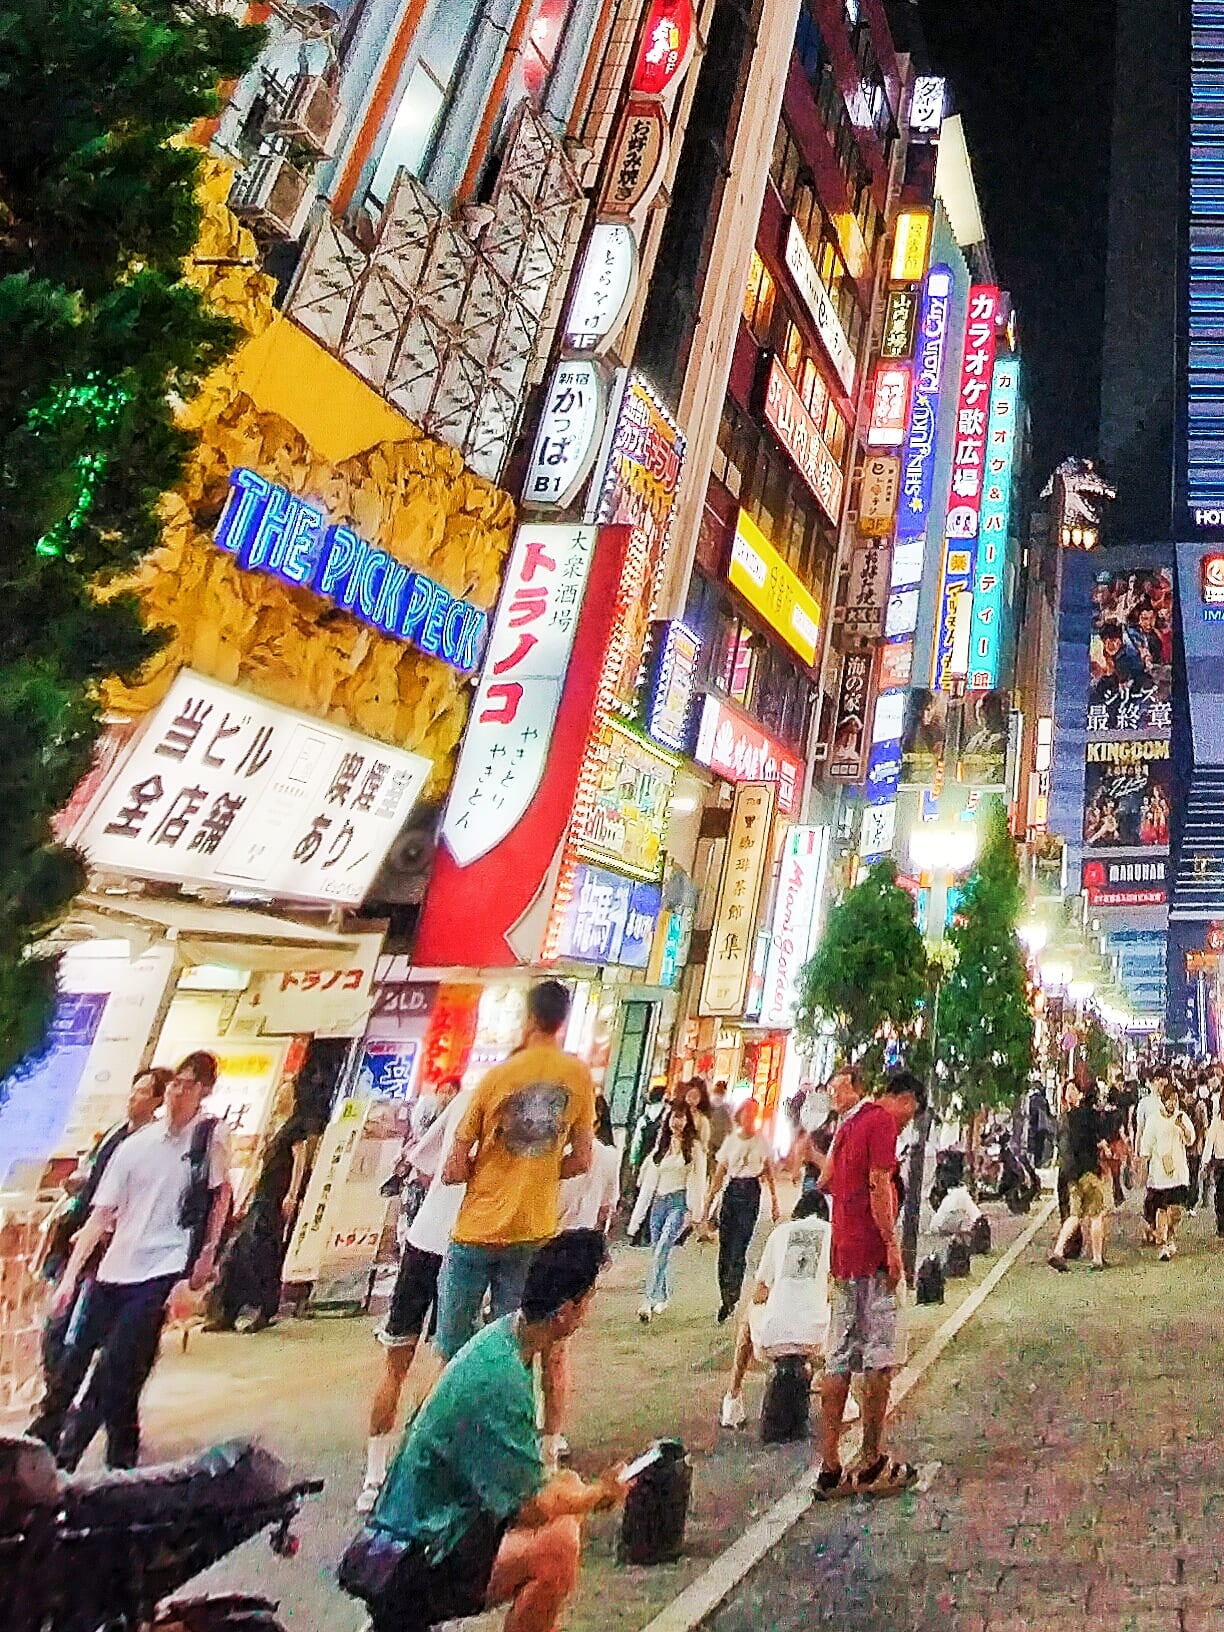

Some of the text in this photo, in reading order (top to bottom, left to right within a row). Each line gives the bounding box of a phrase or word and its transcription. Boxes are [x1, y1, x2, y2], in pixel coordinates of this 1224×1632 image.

[917, 81, 938, 122] ダーツ
[614, 119, 652, 202] お好み焼き
[558, 372, 590, 386] 新宿
[952, 294, 995, 498] カラオケ歌広場
[536, 386, 586, 467] かっぱ
[903, 404, 934, 497] SHINJUKU
[533, 475, 562, 493] B1
[224, 467, 487, 670] THE PICK PECK
[547, 530, 589, 633] 大衆酒場
[478, 541, 556, 726] トラノコ
[845, 657, 867, 711] 海の家
[1086, 702, 1173, 731] 最終章
[1103, 686, 1159, 706] シリーズ
[153, 696, 275, 779] 当ビル
[492, 724, 539, 812] やきとり
[1086, 739, 1171, 764] KINGDOM
[103, 773, 248, 856] 全店舗
[454, 741, 508, 829] やきとん
[291, 812, 356, 872] あり
[279, 968, 365, 993] トラノコ
[718, 934, 743, 962] 集
